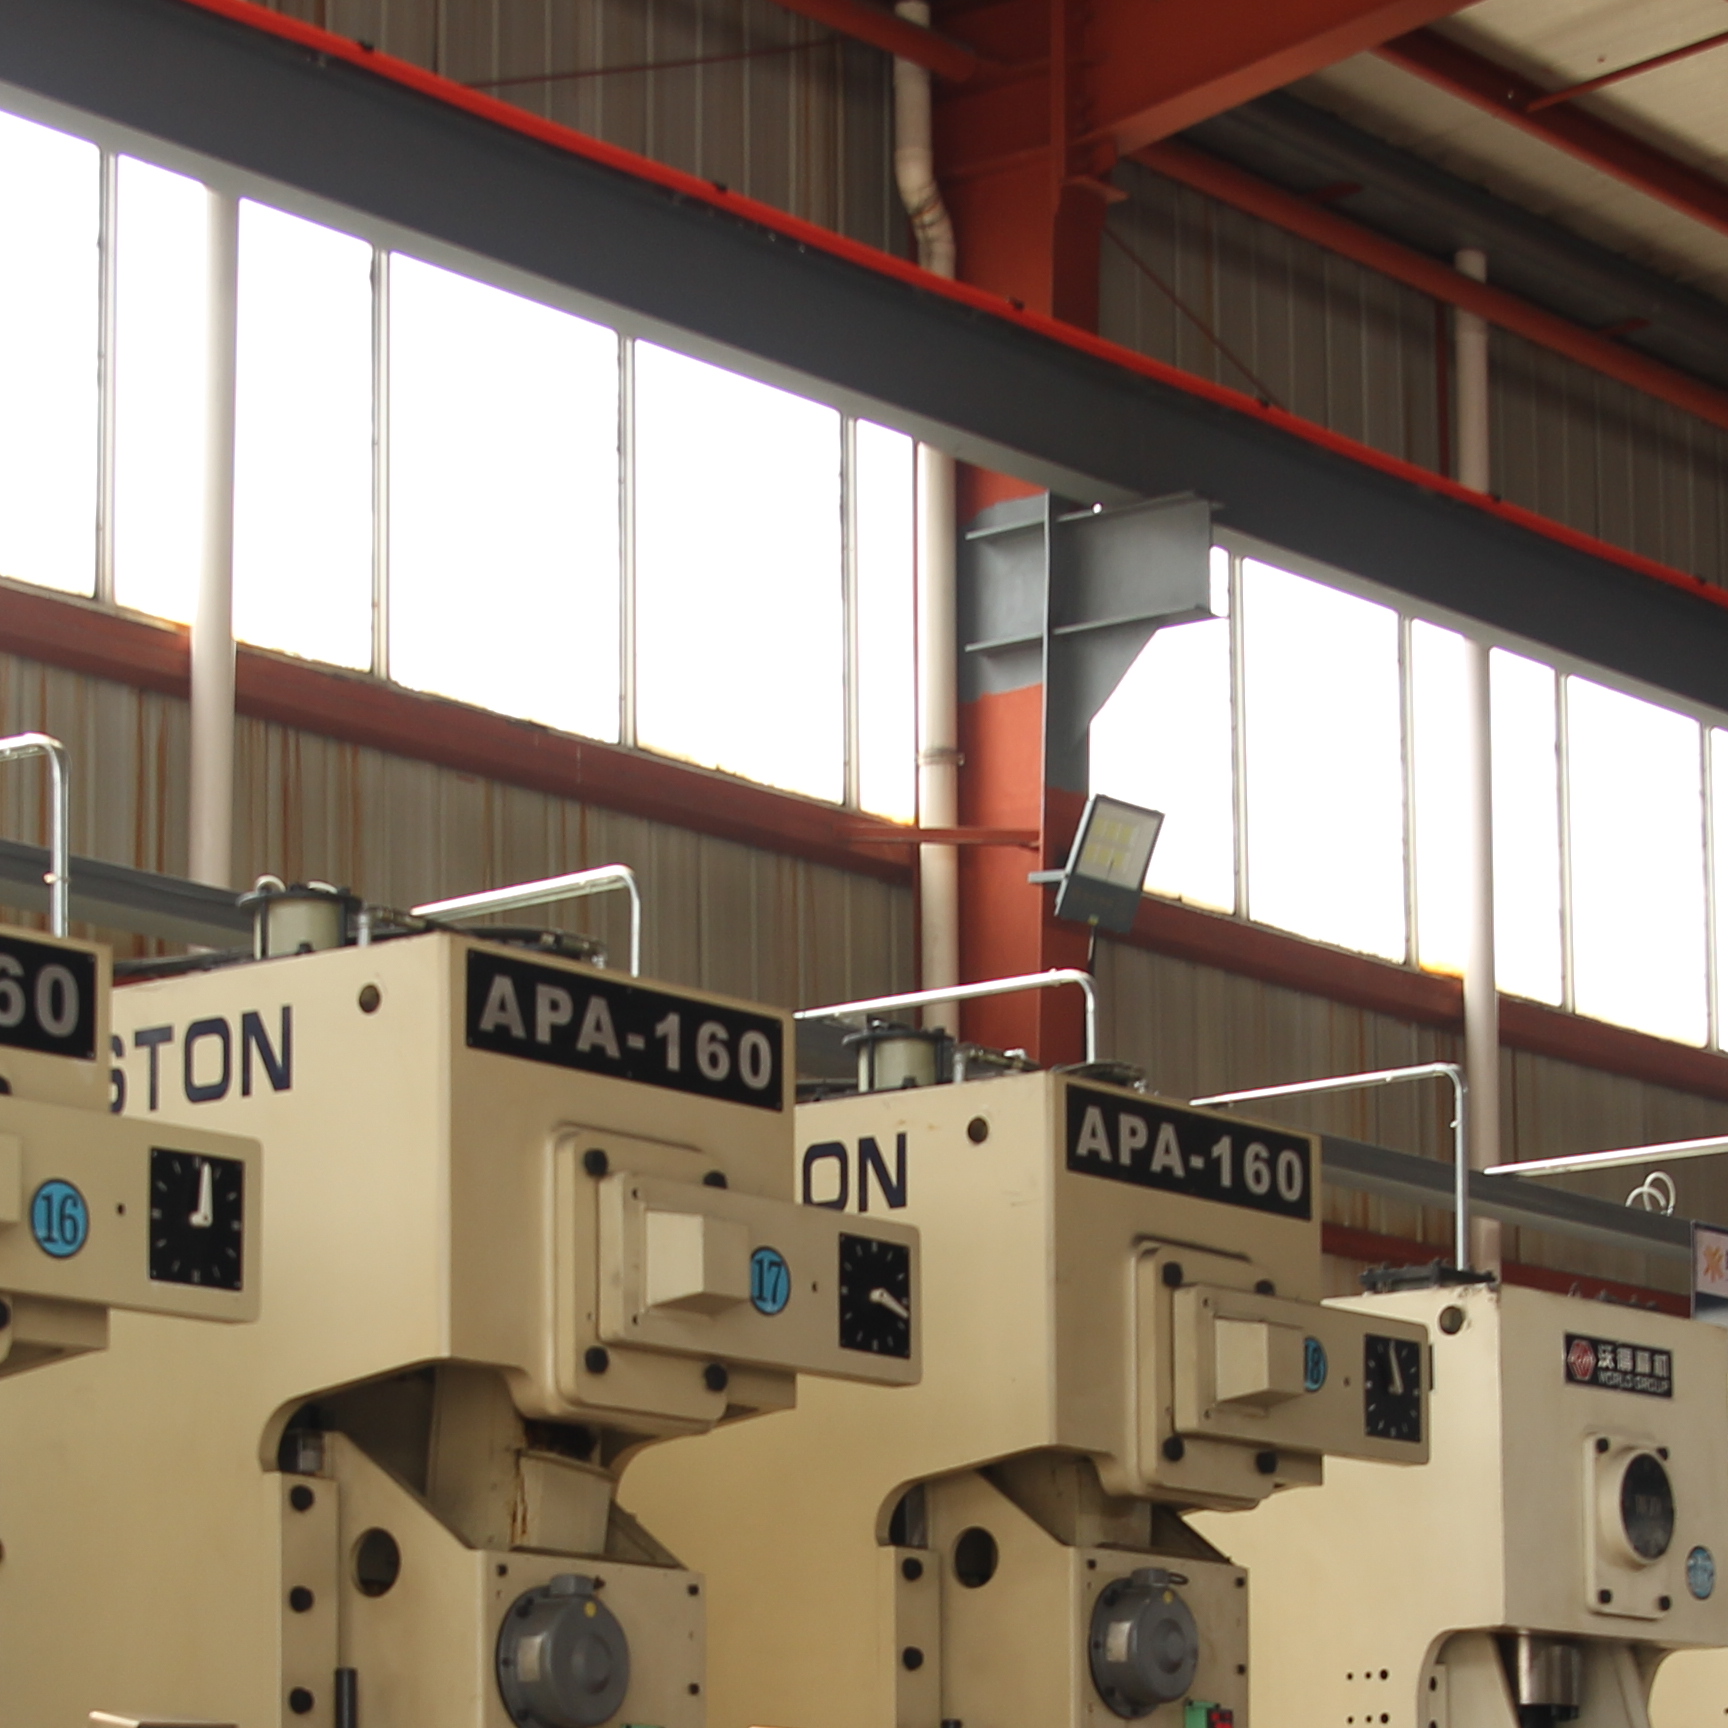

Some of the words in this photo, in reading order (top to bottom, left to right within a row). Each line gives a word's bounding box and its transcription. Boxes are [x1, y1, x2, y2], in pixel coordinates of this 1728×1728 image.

[479, 974, 771, 1090] APA-160
[1076, 1105, 1303, 1201] APA-160
[42, 1193, 80, 1245] 16
[755, 1258, 782, 1303] 17
